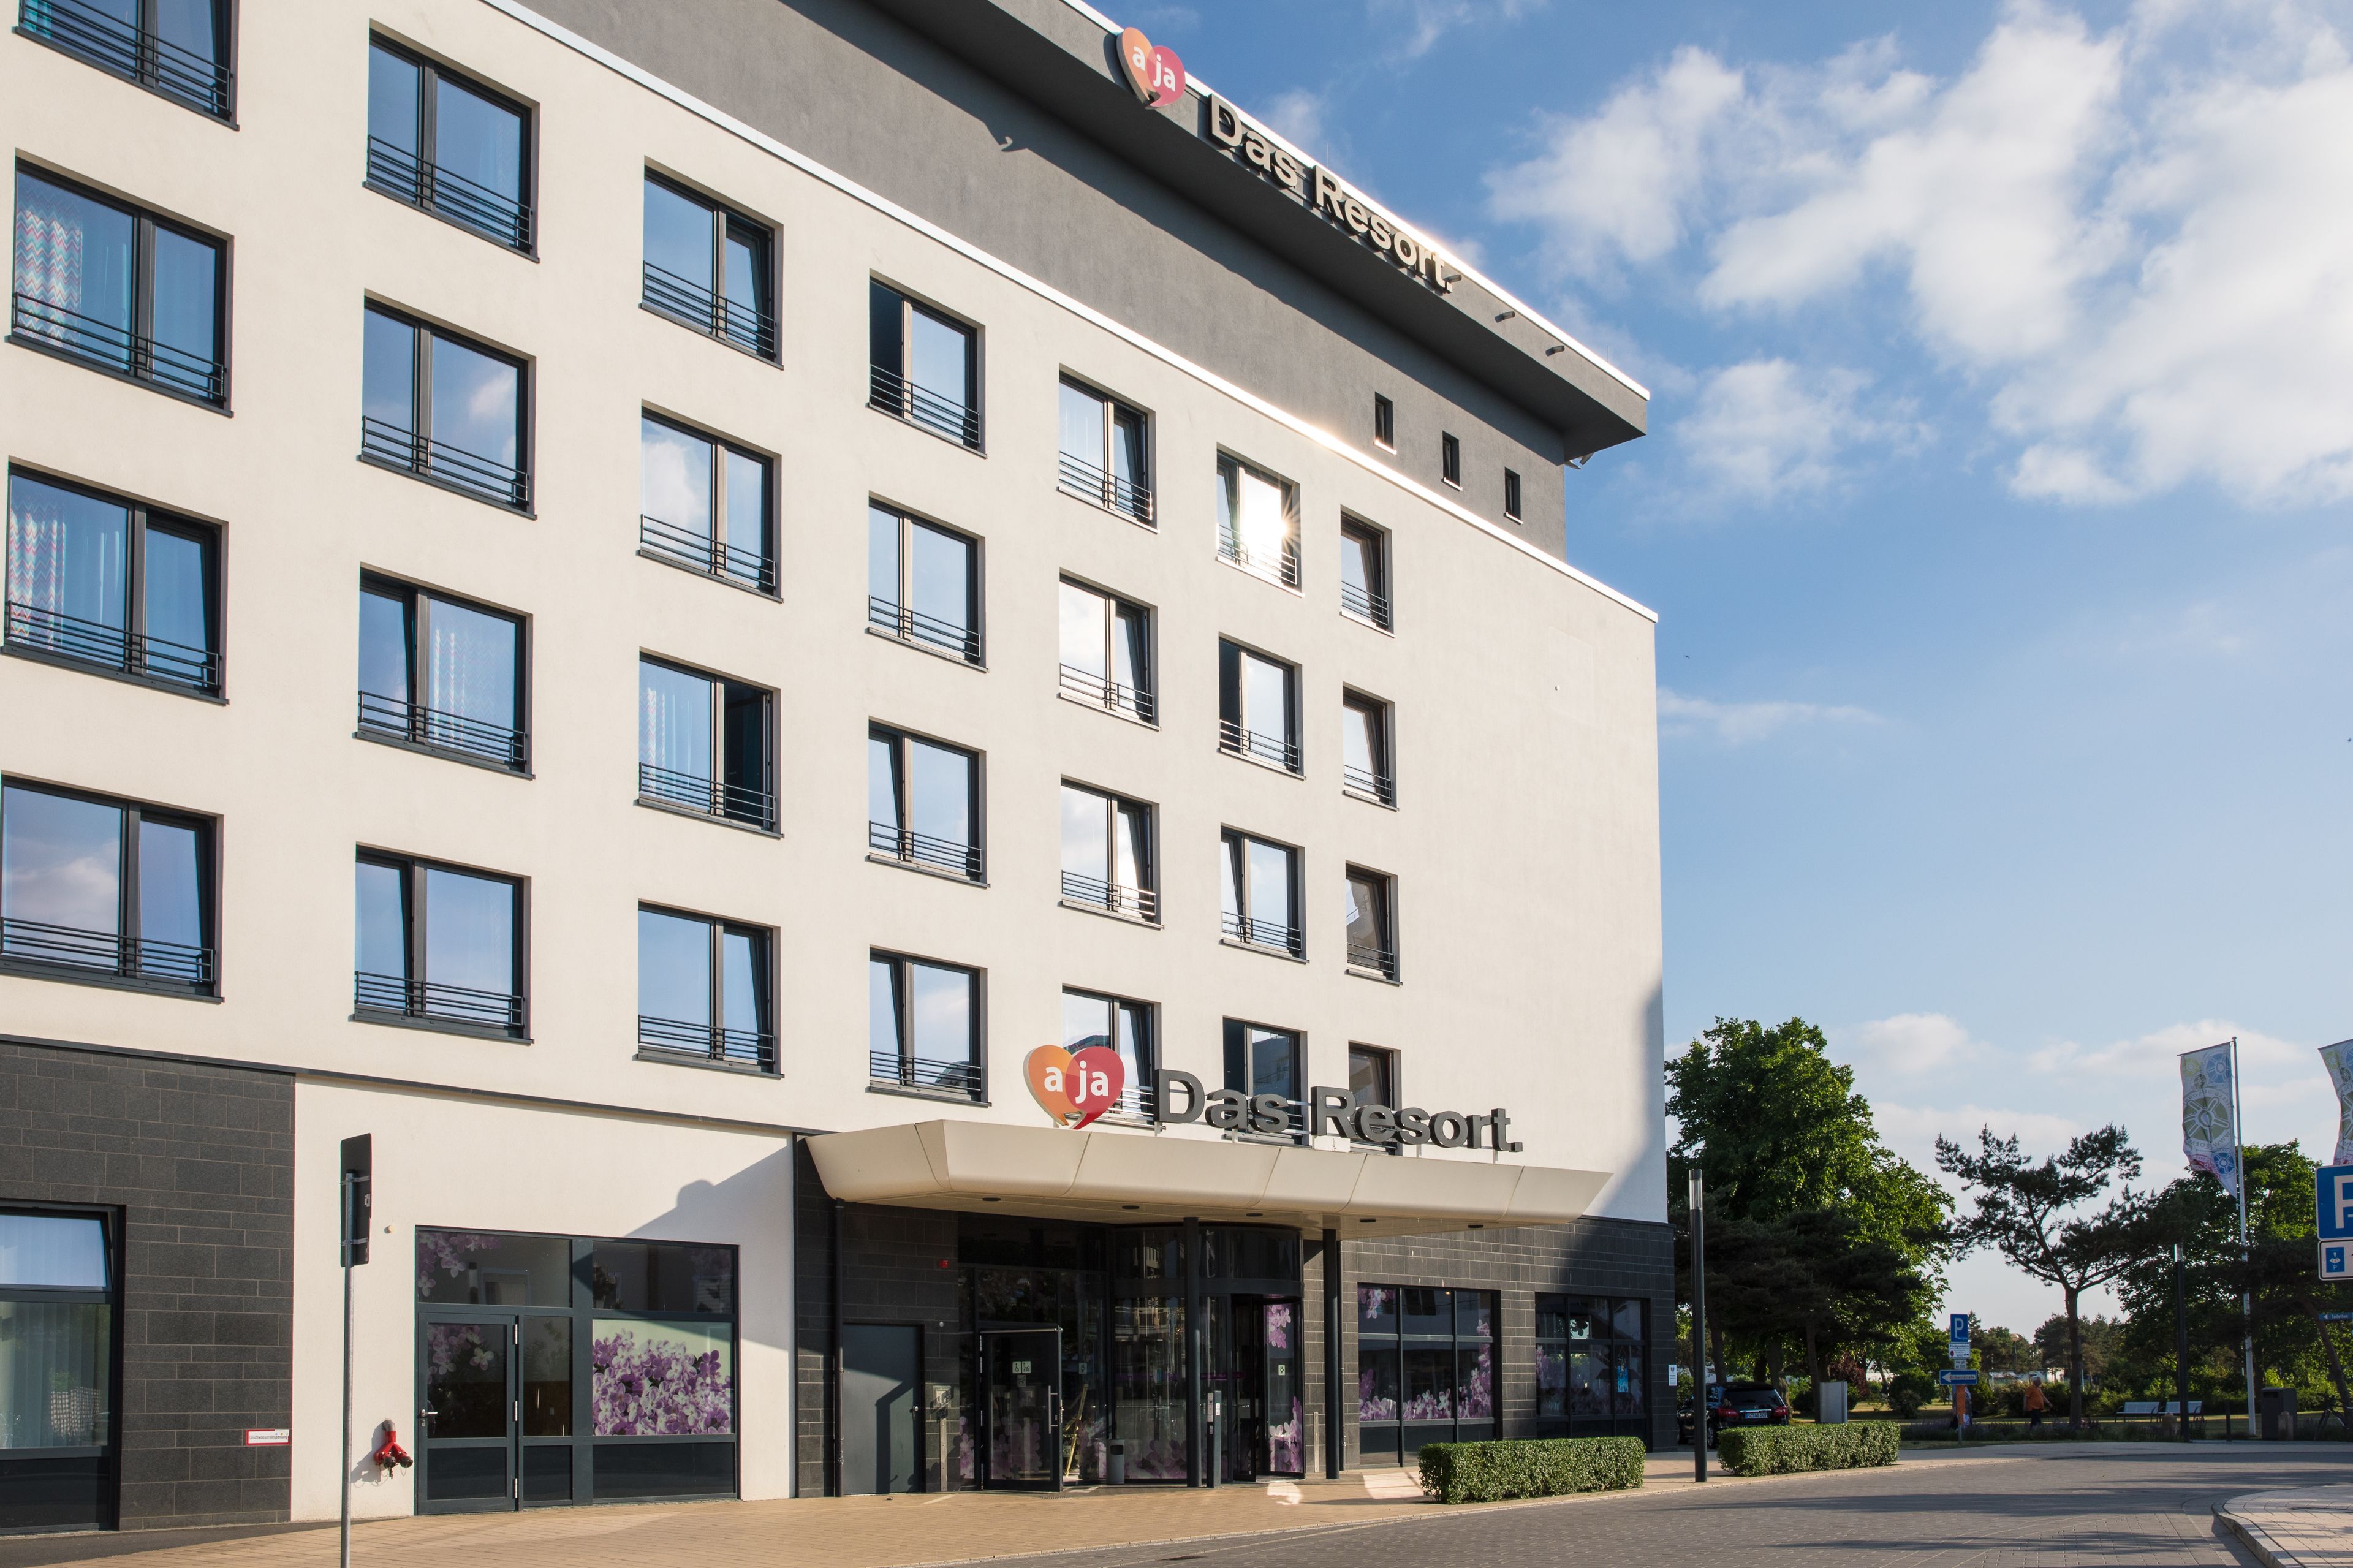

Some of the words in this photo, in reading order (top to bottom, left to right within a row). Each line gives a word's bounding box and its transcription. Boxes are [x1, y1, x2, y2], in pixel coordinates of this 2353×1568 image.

[1207, 94, 1298, 188] Das
[1313, 165, 1454, 294] Resort.
[1153, 1069, 1290, 1134] Das
[1311, 1085, 1523, 1153] Resort.
[1955, 1317, 1964, 1339] P
